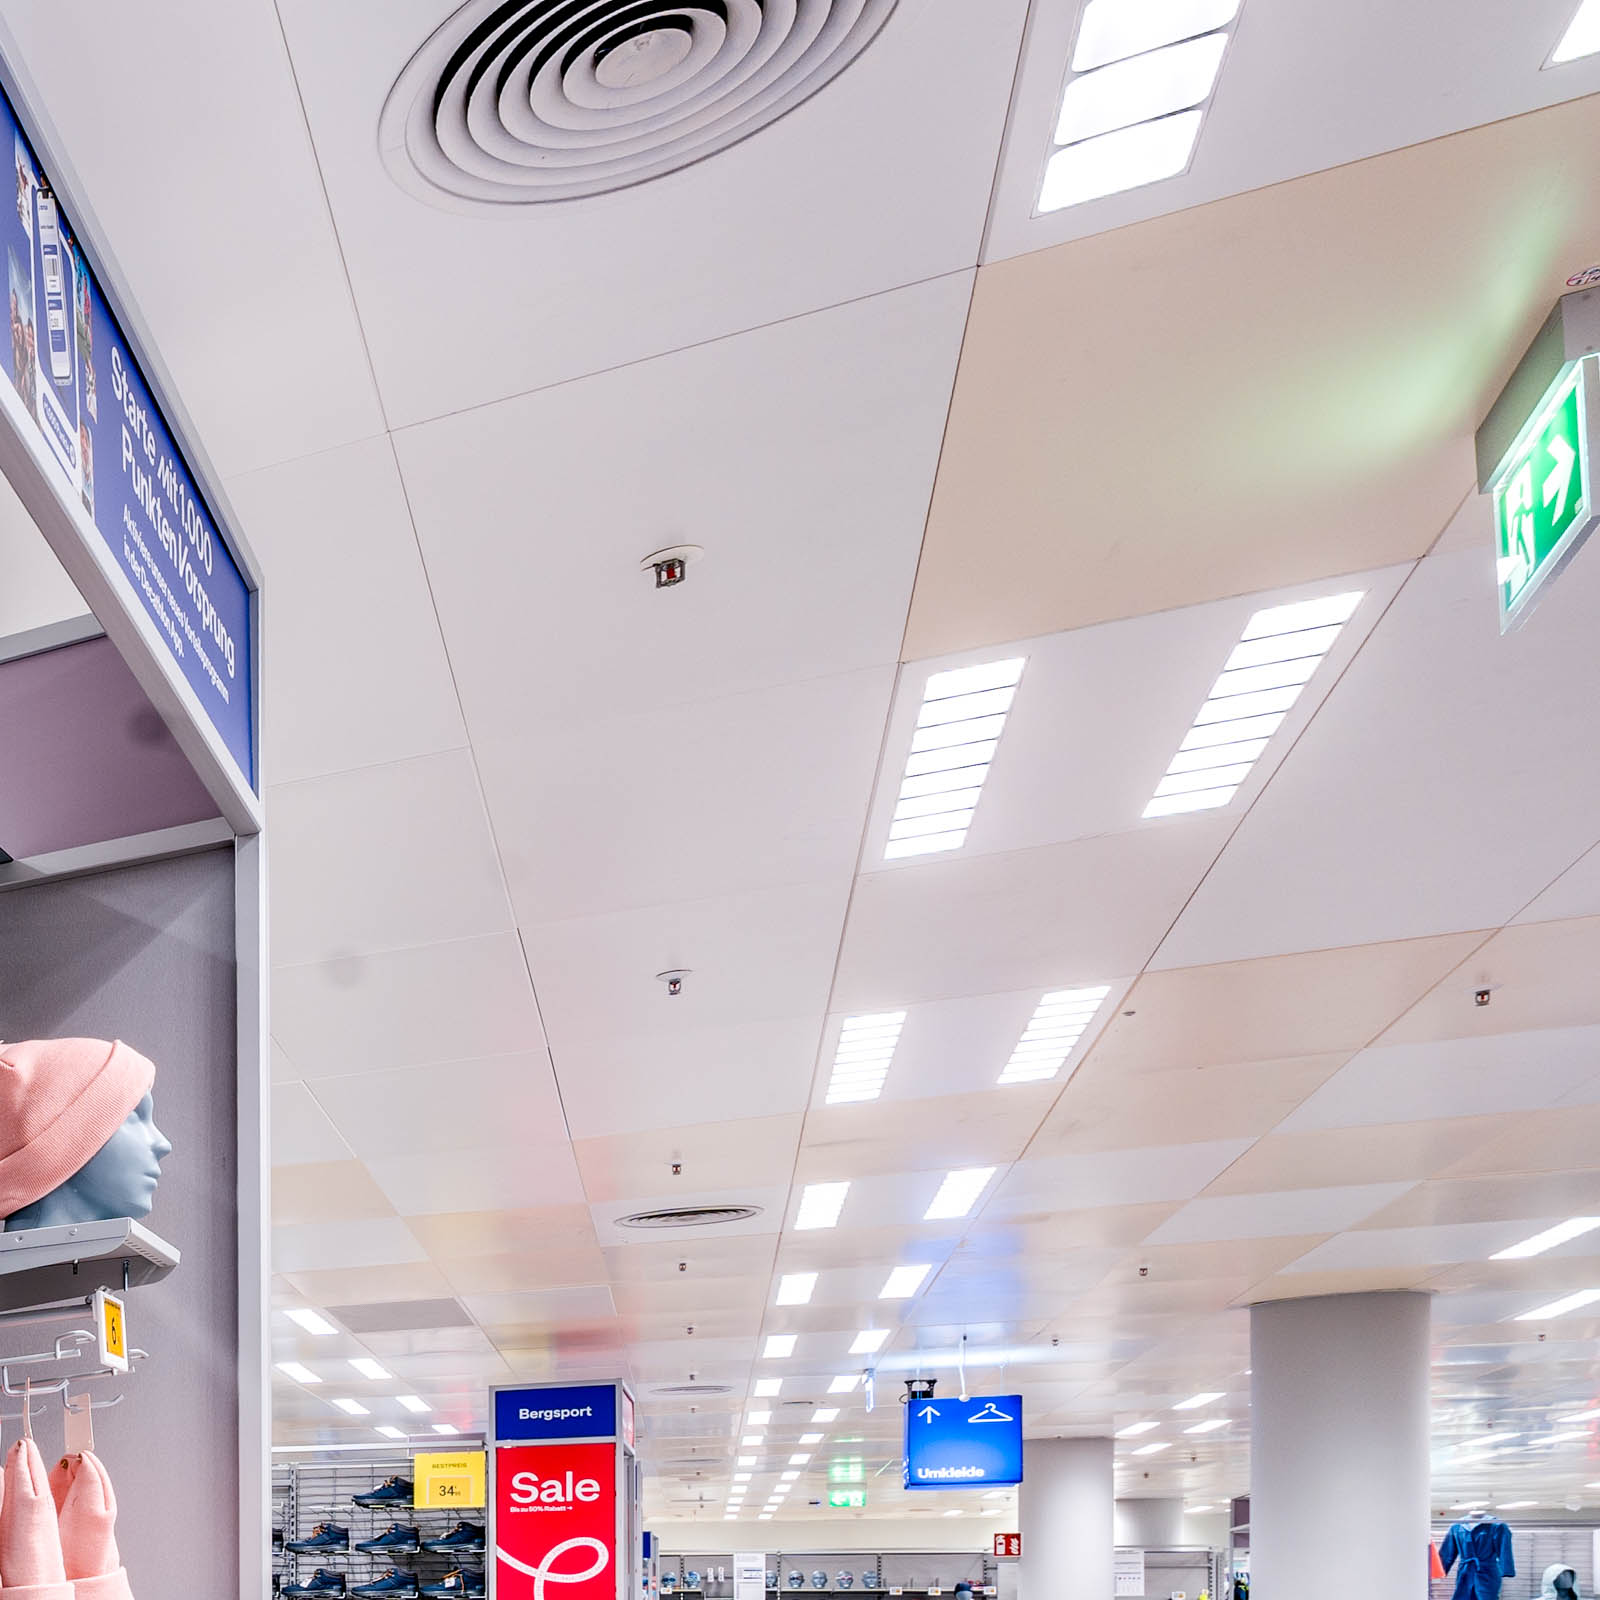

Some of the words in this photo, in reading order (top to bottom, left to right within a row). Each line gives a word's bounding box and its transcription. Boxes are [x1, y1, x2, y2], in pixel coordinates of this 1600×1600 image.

[111, 347, 156, 466] Starte
[179, 483, 213, 576] 1.000
[122, 424, 178, 568] Punkten
[178, 533, 235, 678] Vorsprung
[111, 1317, 117, 1344] 6
[519, 1406, 593, 1421] Bergsport
[510, 1471, 601, 1504] Sale
[917, 1466, 985, 1479] Umkleide
